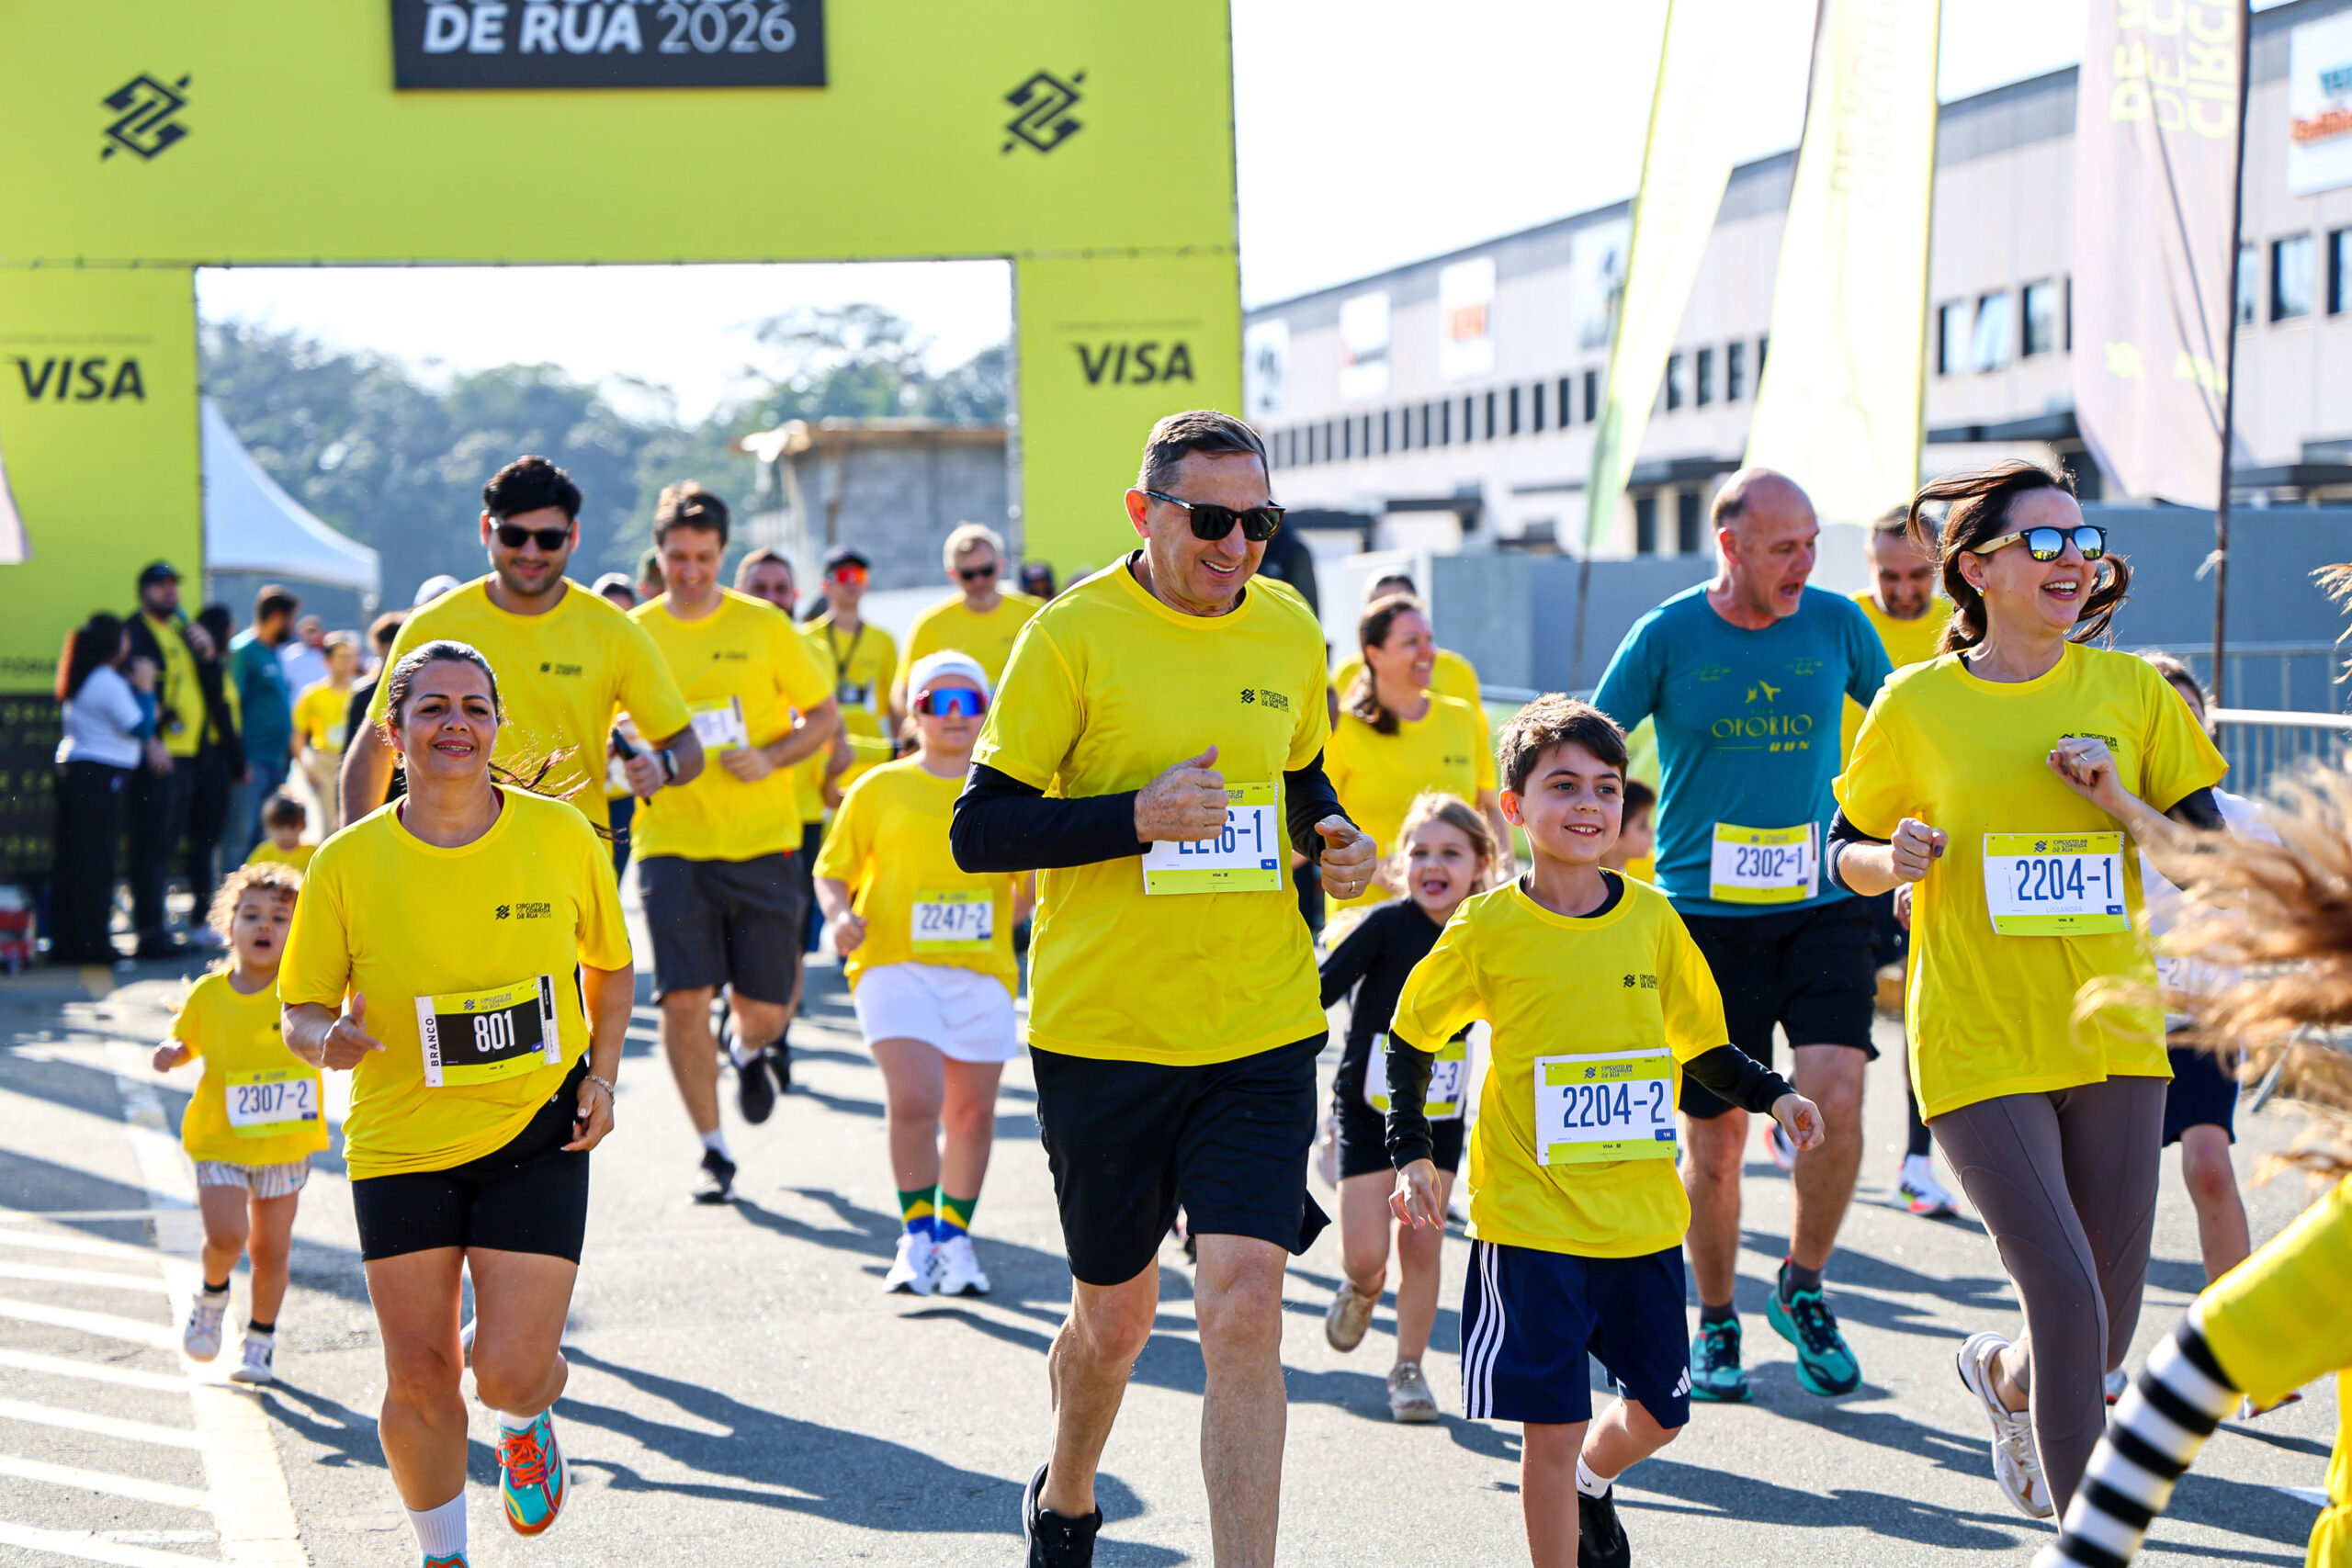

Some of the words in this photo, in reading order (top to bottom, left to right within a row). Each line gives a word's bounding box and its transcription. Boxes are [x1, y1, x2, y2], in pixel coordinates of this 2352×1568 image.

[423, 3, 506, 53] DE
[519, 3, 643, 53] RUA
[657, 3, 797, 53] 2026
[13, 356, 146, 400] VISA
[1073, 342, 1194, 384] VISA
[1736, 845, 1803, 877] 2302-1
[2015, 858, 2112, 901] 2204-1
[922, 903, 987, 930] 2247-2
[425, 1018, 439, 1067] BRANCO
[473, 1010, 515, 1053] 801
[238, 1080, 308, 1114] 2307-2
[1563, 1081, 1666, 1128] 2204-2
